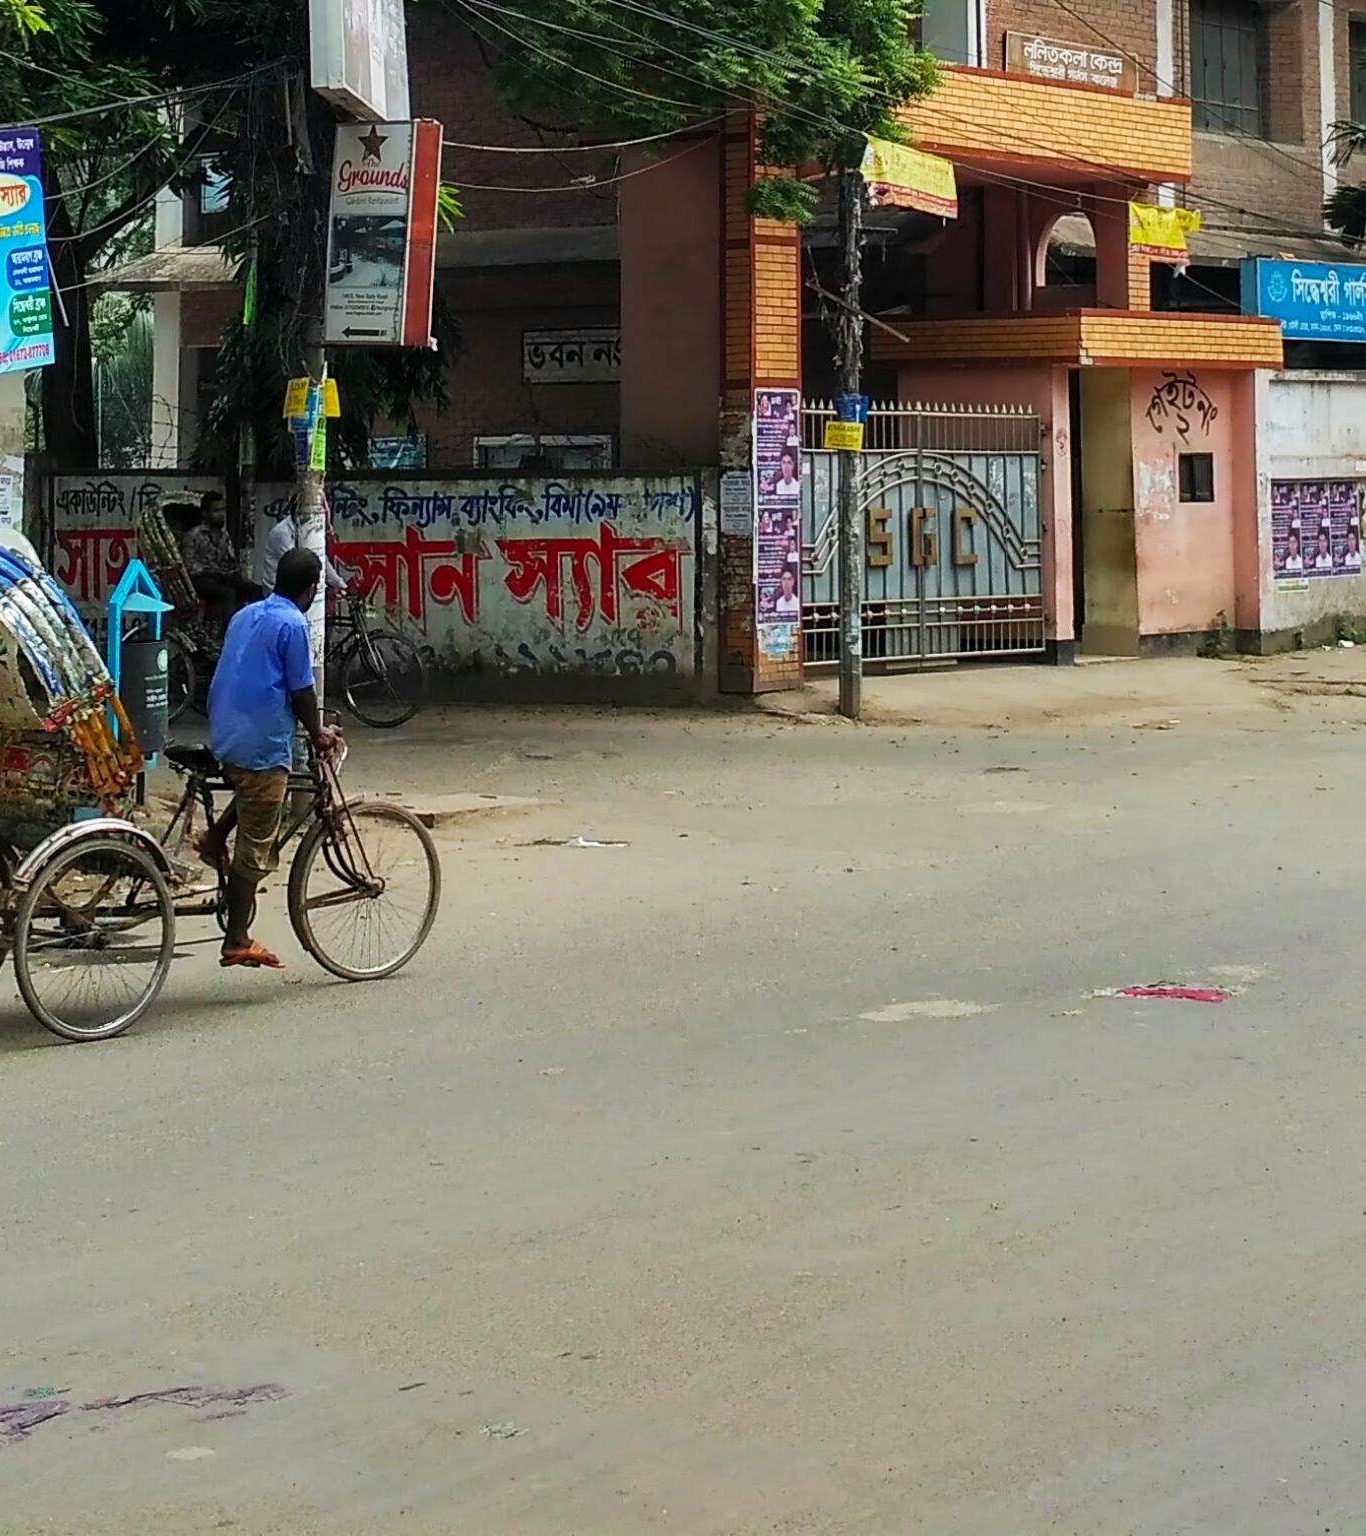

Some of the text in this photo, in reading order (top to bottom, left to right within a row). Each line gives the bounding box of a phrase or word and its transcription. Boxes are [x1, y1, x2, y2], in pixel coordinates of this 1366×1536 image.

[1023, 38, 1123, 75] ললিতকলা কেন্দ্র
[337, 159, 408, 192] Grounds
[1290, 268, 1340, 307] সিদ্ধেশ্বরী
[525, 340, 587, 370] ভবন
[56, 480, 126, 516] একাউন্টিং
[493, 520, 691, 634] স্যার
